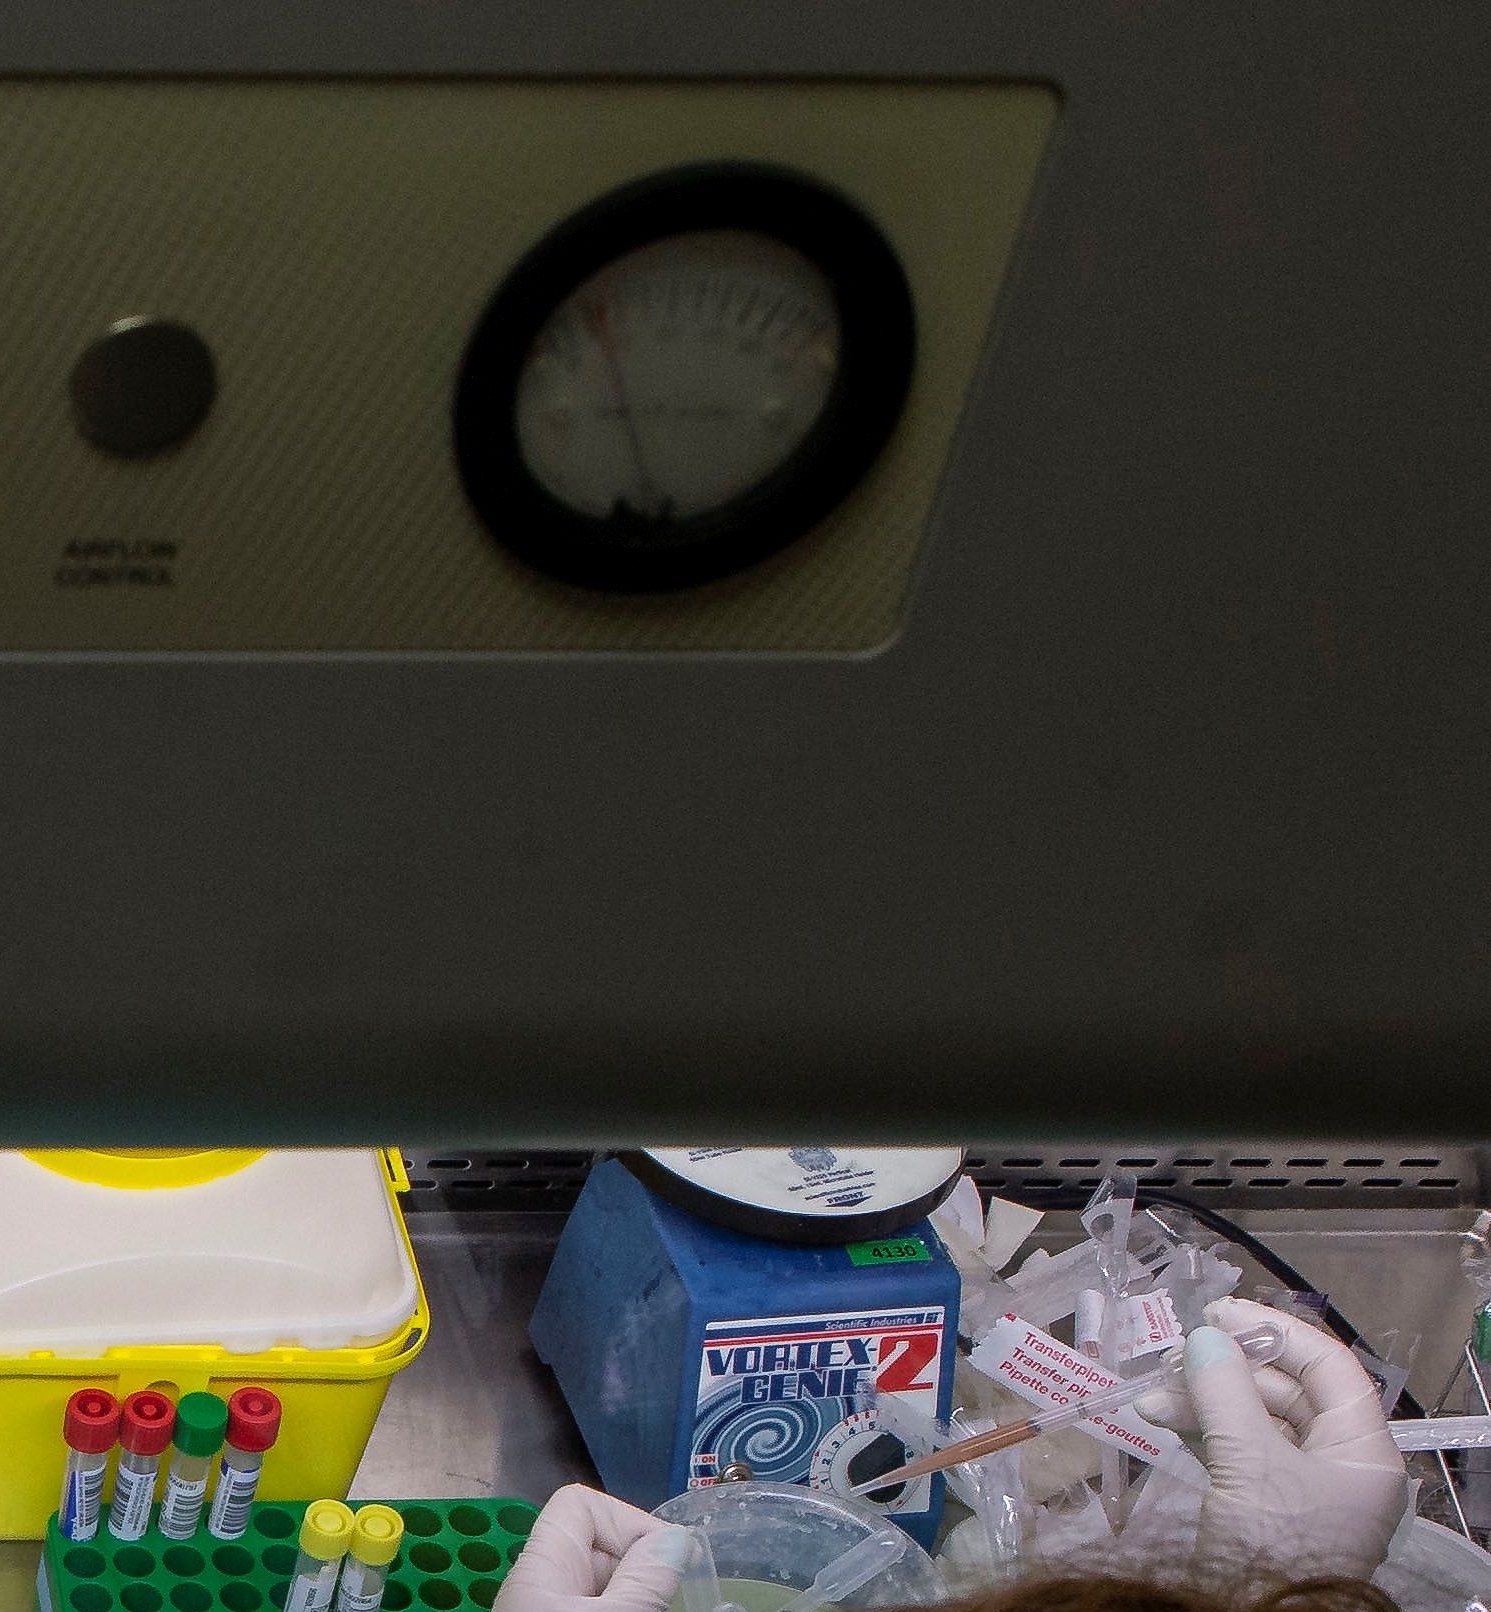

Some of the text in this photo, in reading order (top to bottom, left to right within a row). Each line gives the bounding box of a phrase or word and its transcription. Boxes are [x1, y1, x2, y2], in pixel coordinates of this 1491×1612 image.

[872, 1244, 917, 1259] 4130
[824, 1315, 918, 1331] Scientific Industries
[876, 1333, 939, 1394] 2
[999, 1360, 1049, 1395] Pipette
[1012, 1347, 1069, 1386] Transfer
